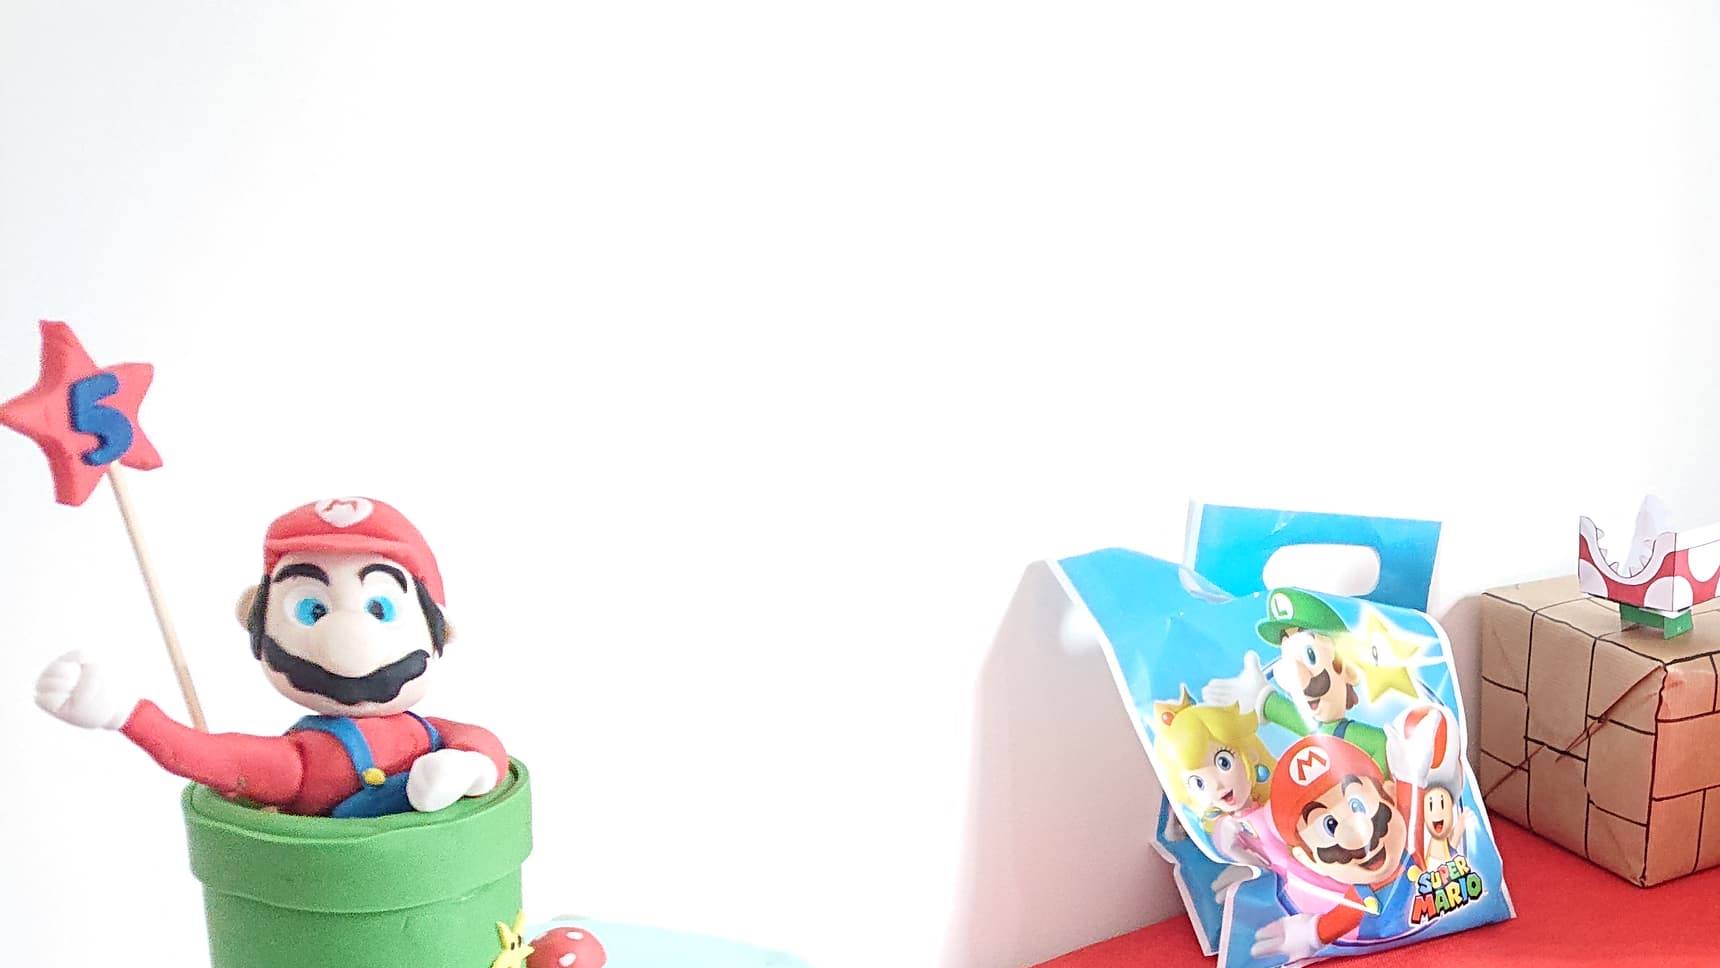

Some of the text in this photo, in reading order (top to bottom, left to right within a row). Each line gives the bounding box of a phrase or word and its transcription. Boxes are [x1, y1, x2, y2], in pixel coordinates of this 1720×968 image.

[68, 371, 133, 466] 5
[1274, 598, 1288, 617] L
[1296, 750, 1327, 781] M
[1418, 854, 1471, 895] SUPER
[1411, 871, 1483, 925] MARIO
